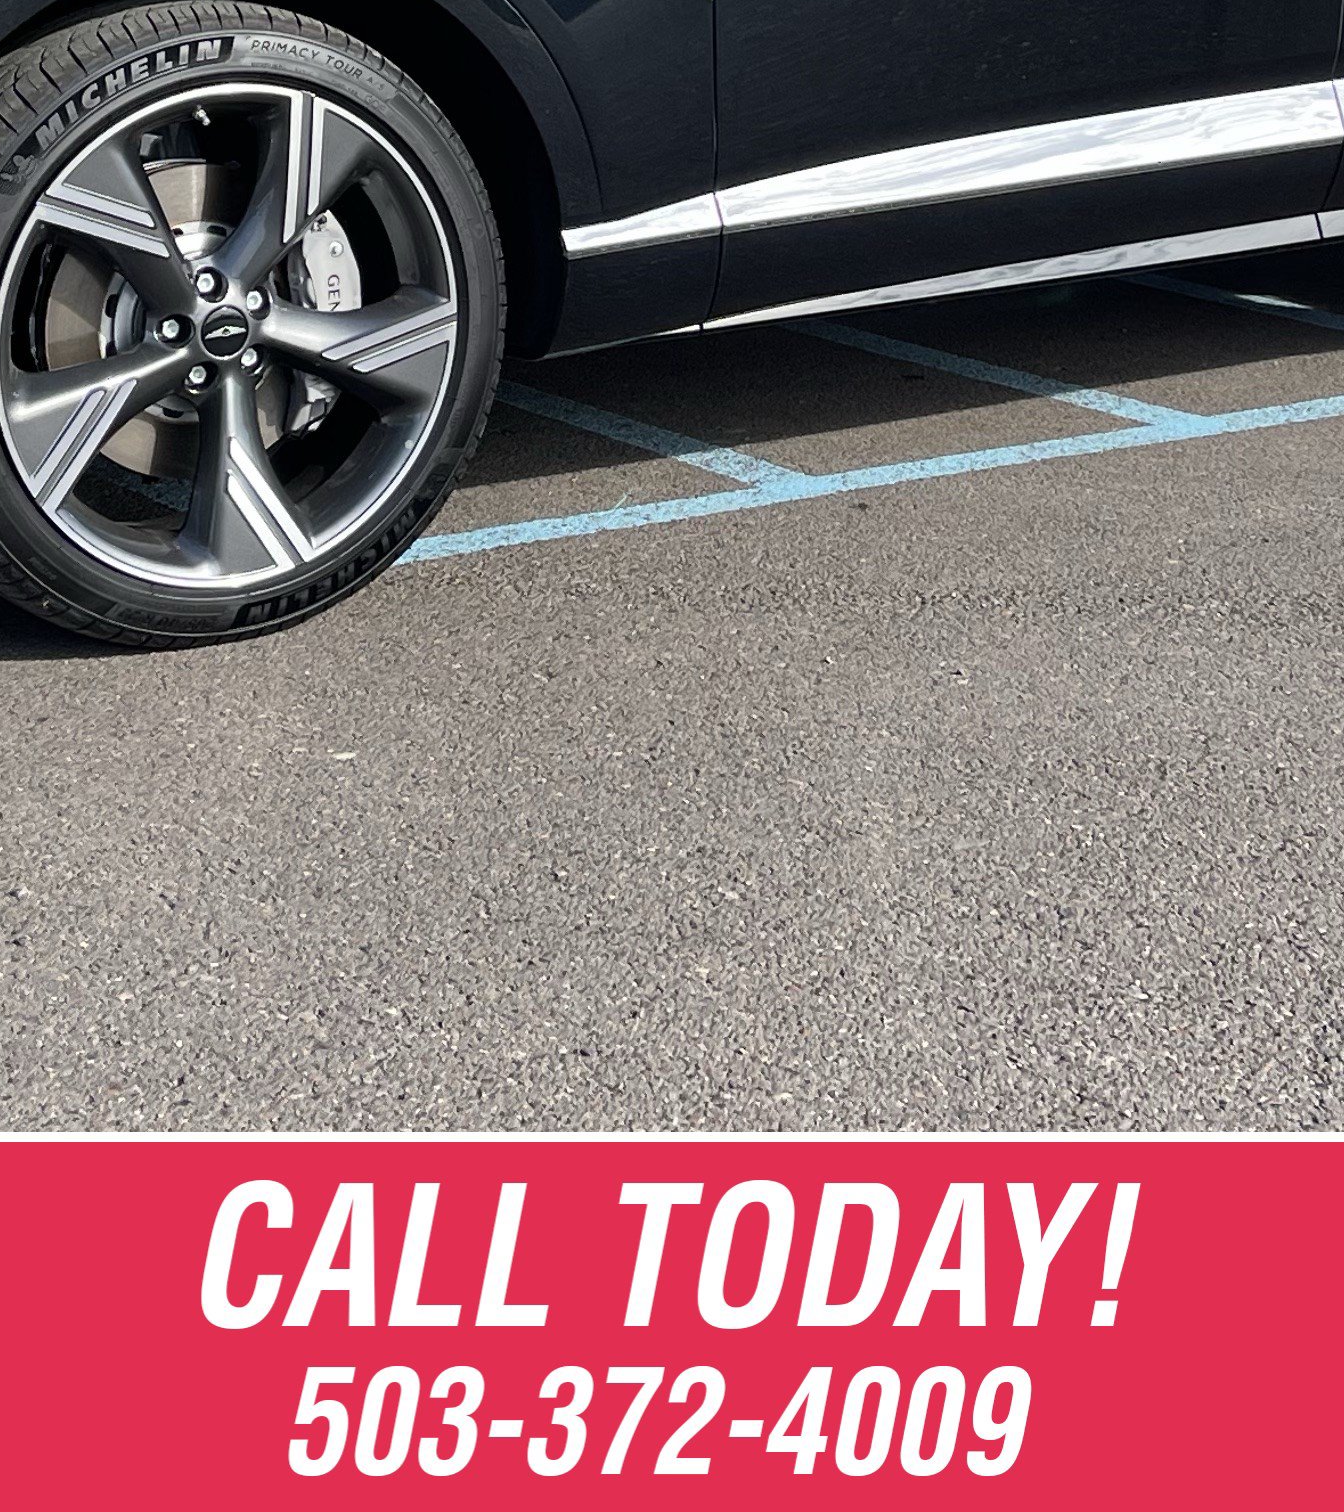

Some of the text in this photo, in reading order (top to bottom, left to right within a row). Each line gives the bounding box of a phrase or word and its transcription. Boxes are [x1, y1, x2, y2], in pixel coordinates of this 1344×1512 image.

[35, 39, 222, 151] MICHELIN
[250, 40, 320, 59] PRIMACY
[326, 55, 364, 80] TOUR
